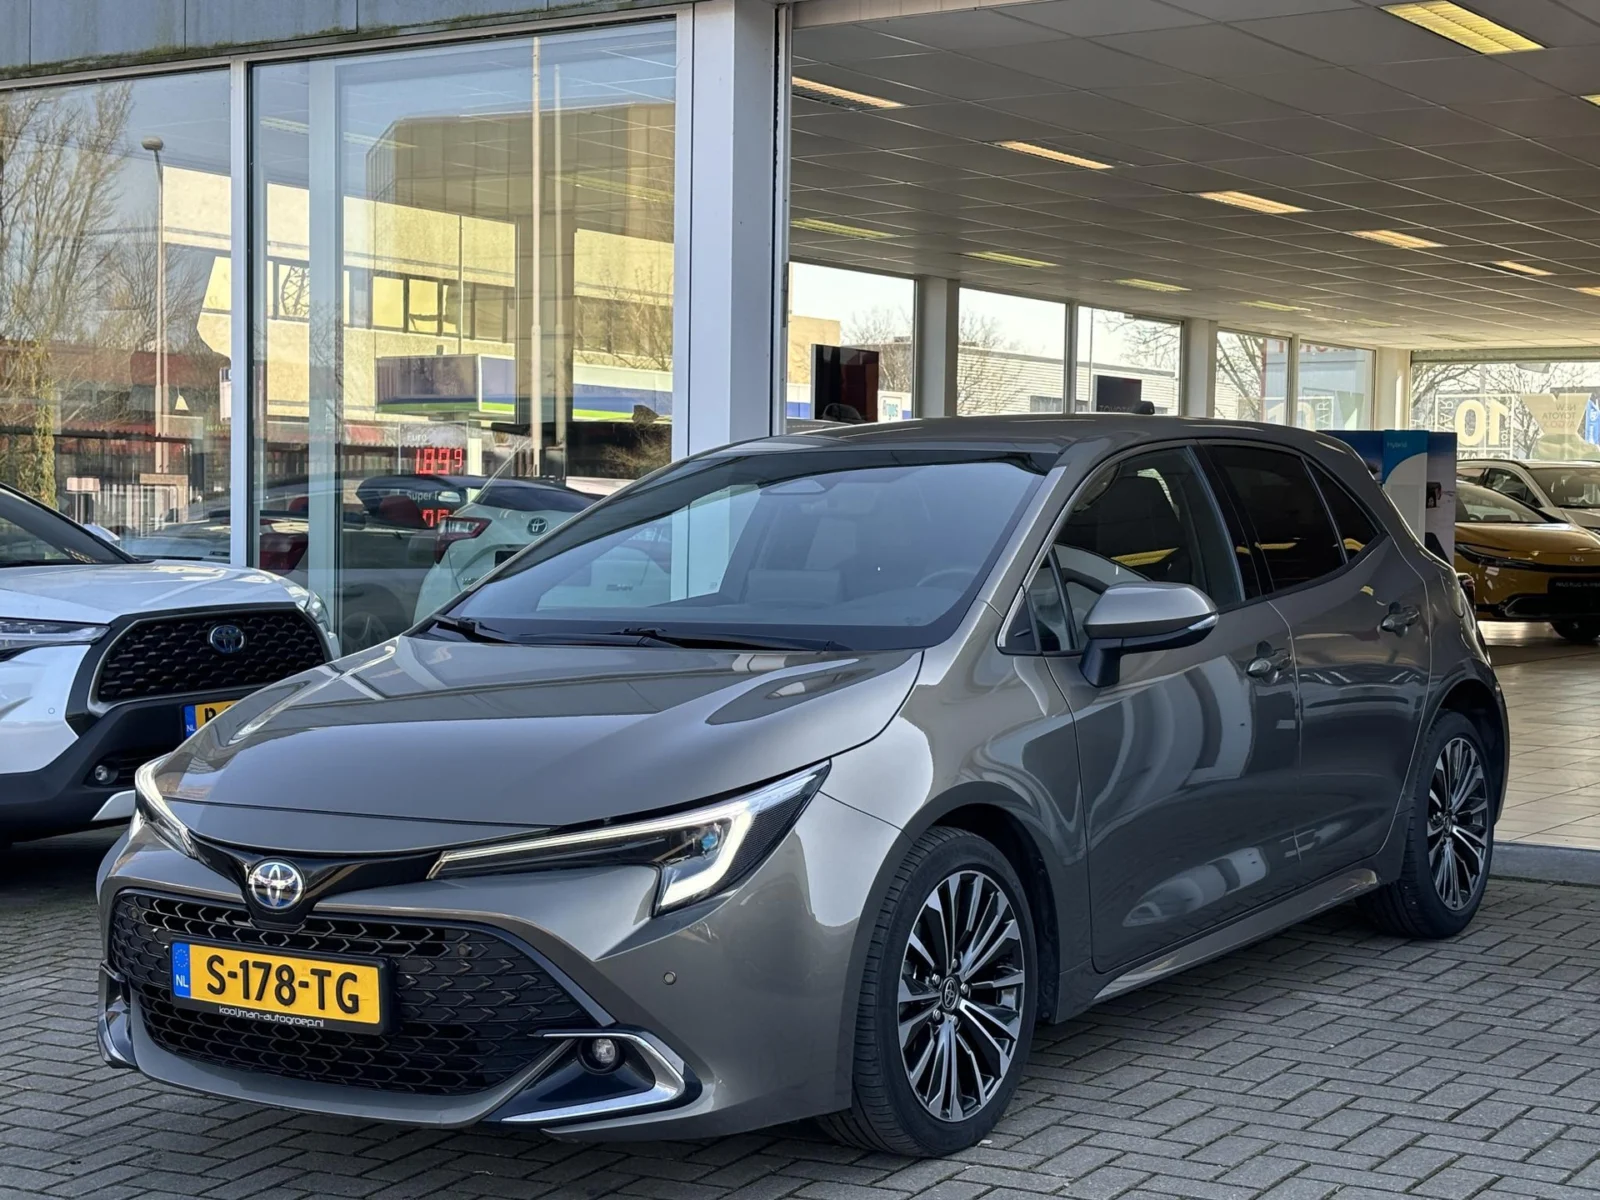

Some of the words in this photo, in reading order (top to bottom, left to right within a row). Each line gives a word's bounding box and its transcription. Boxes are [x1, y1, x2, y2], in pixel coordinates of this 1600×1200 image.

[175, 974, 189, 988] NL
[206, 954, 360, 1014] S-178-TG
[218, 1005, 324, 1028] kooijman-autogroep.nl
